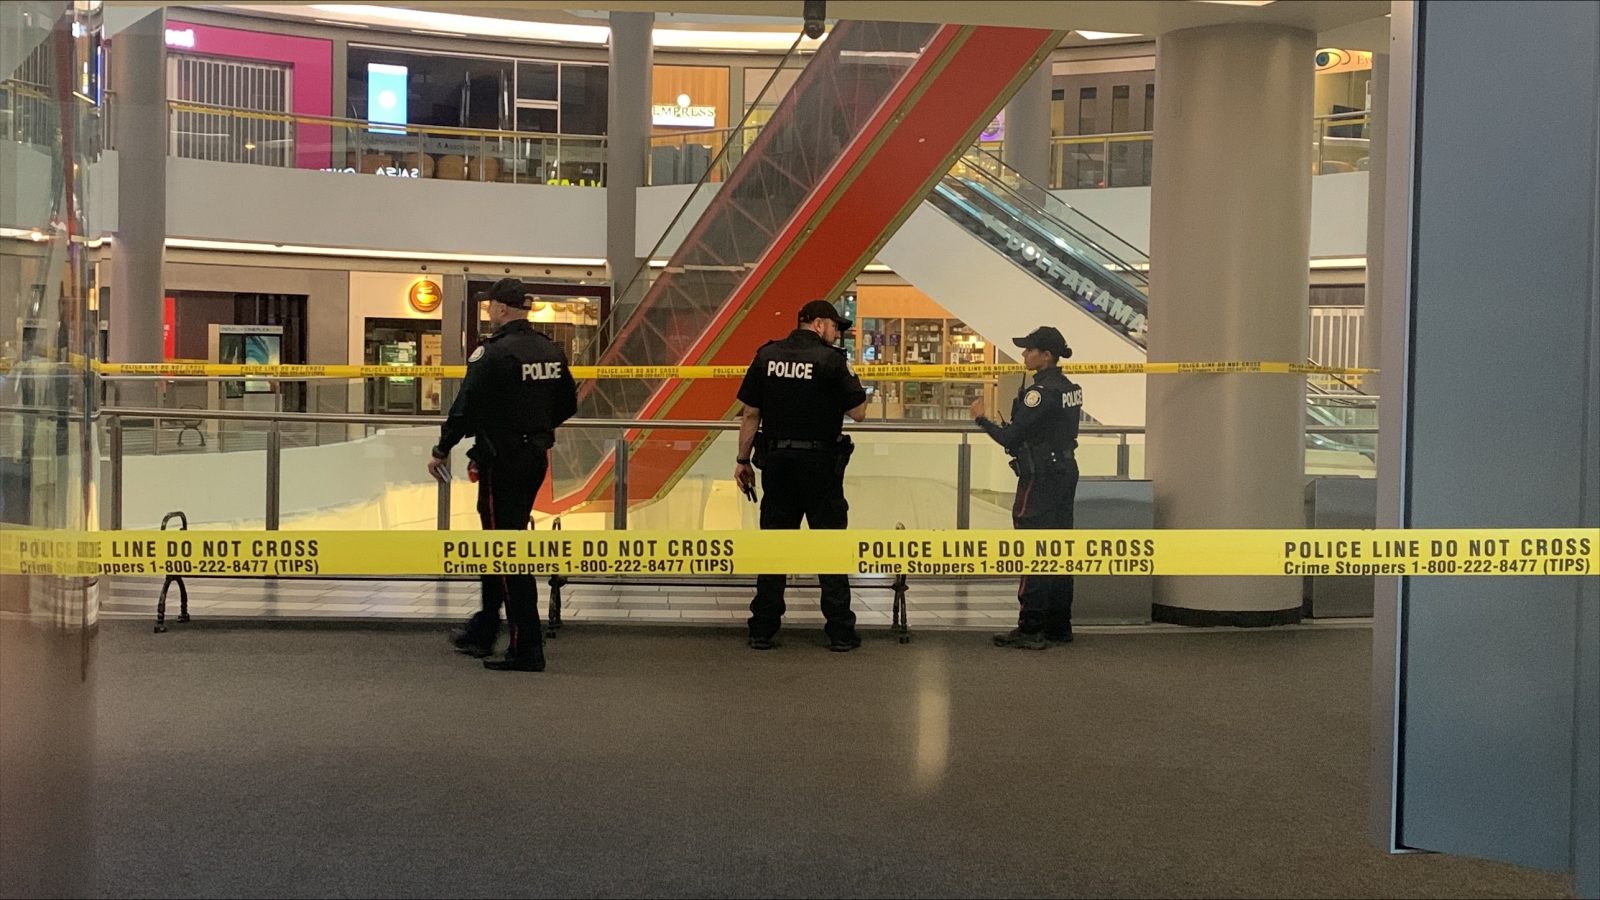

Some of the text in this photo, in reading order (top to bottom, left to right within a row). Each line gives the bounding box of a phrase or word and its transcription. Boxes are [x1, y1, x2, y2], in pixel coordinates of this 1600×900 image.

[522, 362, 561, 381] POLICE
[767, 360, 813, 380] POLICE
[1062, 389, 1083, 409] POLICE
[112, 541, 156, 557] LINE
[167, 541, 192, 557] DO
[203, 541, 241, 557] NOT
[253, 541, 319, 557] CROSS
[444, 540, 734, 557] POLICE LINE DO NOT CROSS
[859, 540, 1154, 557] POLICE LINE DO NOT CROSS
[1285, 538, 1590, 557] POLICE LINE DO NOT CROSS
[150, 560, 268, 573] 1-800-222-8477
[274, 559, 319, 575] (TIPS)
[444, 559, 734, 575] Crime Stoppers 1-800-222-8477 (TIPS)
[858, 559, 1154, 575] Crime Stoppers 1-800-222-8477 (TIPS)
[1284, 559, 1590, 575] Crime Stoppers 1-800-222-8477 (TIPS)
